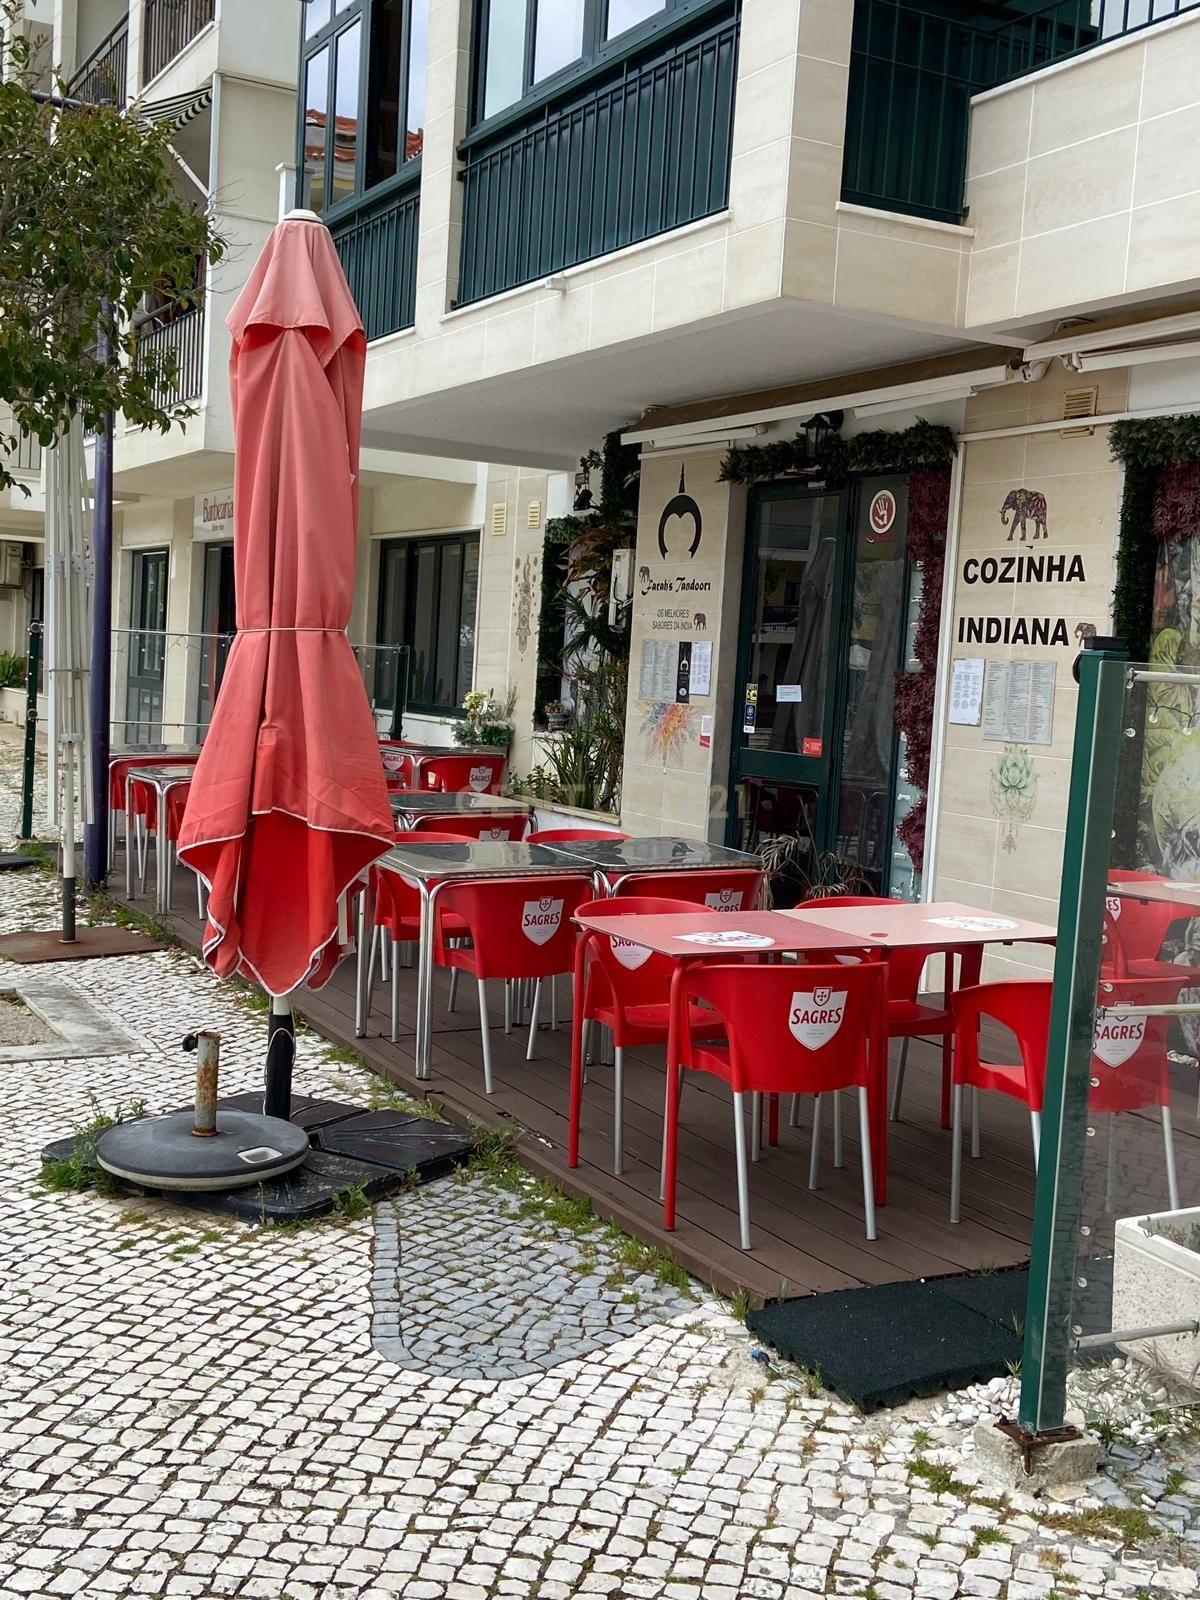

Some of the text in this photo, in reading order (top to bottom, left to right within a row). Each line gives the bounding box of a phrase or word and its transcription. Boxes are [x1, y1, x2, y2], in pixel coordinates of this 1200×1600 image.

[963, 554, 1086, 585] COZINHA
[675, 577, 711, 593] Tandoori
[657, 609, 689, 619] OS MELHORES
[652, 621, 673, 630] SABORES
[674, 621, 680, 630] DA
[958, 617, 1069, 647] INDIANA
[470, 774, 493, 783] SAGRES
[708, 904, 740, 912] AGRES
[523, 911, 561, 927] SAGRES
[791, 1007, 843, 1025] SAGRES
